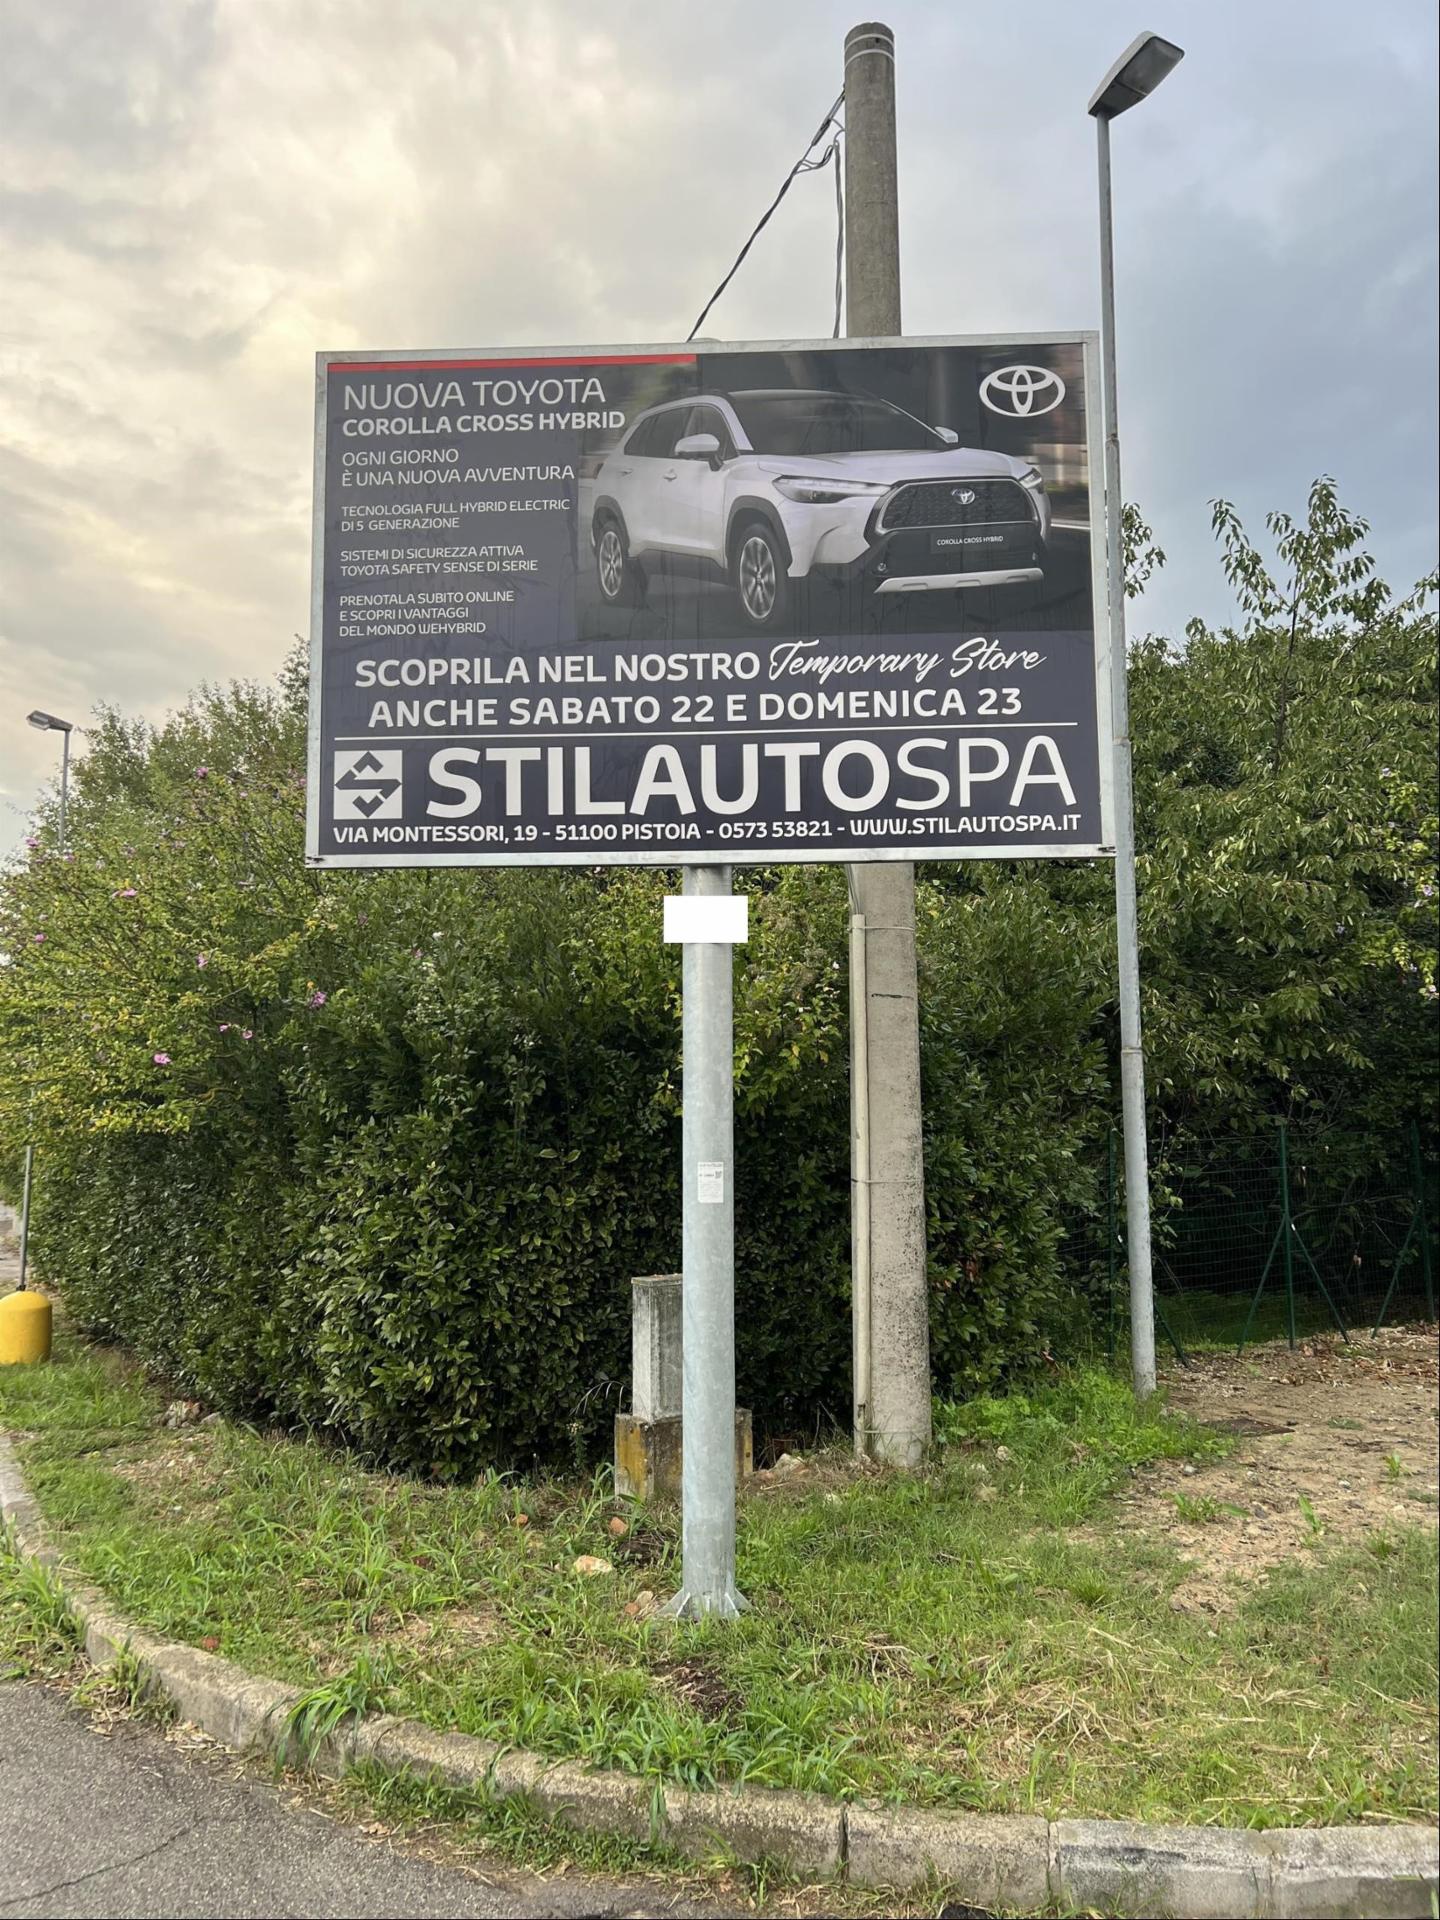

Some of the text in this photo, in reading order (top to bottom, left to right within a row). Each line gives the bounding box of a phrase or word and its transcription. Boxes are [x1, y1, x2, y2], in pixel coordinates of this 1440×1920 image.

[344, 378, 606, 410] NUOVA TOYOTA
[342, 411, 626, 437] COROLLA CROSS HYBRID
[342, 448, 459, 467] OGNI GIORNO
[341, 465, 575, 487] È UNA NUOVA AVVENTURA
[341, 499, 571, 517] TECNOLOGIA FULL HYBRID ELECTRIC
[341, 517, 460, 532] DI 5 GENERAZIONE
[340, 545, 524, 562] SISTEMI DI SICUREZZA ATTIVA
[341, 560, 539, 577] TOYOTA SAFETY SENSE DI SERIE
[339, 590, 515, 606] PRENOTALA SUBITO ONLINE
[339, 611, 348, 621] E
[349, 609, 396, 621] SCOPRI
[403, 607, 469, 620] VANTAGGI
[339, 622, 487, 637] DEL MONDO WEHYBRID
[355, 637, 1047, 688] SCOPRILA NEL NOSTRO Temporary Store
[368, 687, 1022, 728] ANCHE SABATO 22 E DOMENICA 23
[333, 826, 369, 844] VIA
[373, 824, 510, 844] MONTESSORI,
[514, 824, 538, 842] 19
[555, 824, 617, 842] 51100
[622, 823, 701, 841] PISTOIA
[719, 822, 767, 839] 0573
[772, 820, 832, 838] 53821
[850, 813, 1082, 836] WWW.STILAUTOSPA.IT
